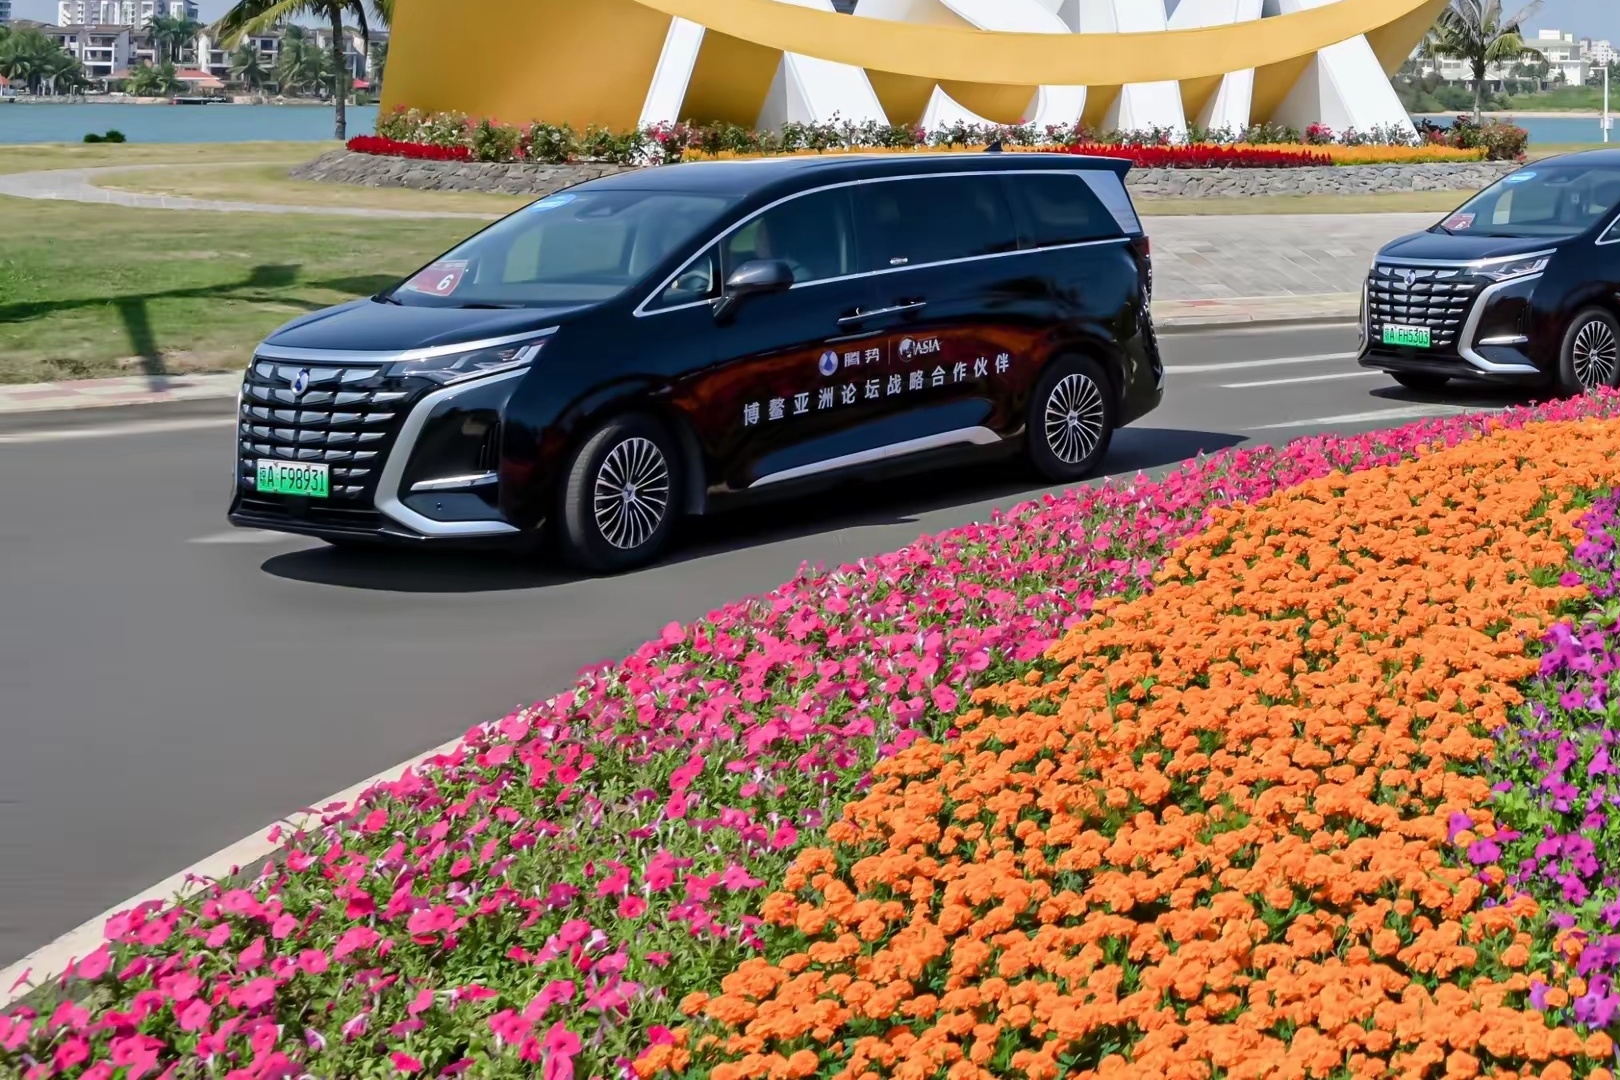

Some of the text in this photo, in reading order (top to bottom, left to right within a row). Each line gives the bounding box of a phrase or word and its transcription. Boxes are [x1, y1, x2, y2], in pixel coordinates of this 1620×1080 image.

[436, 273, 455, 291] 6
[913, 338, 941, 356] ASIA
[743, 352, 1010, 427] 博鳌亚洲论坛战略合作伙伴
[280, 466, 325, 492] F98931
